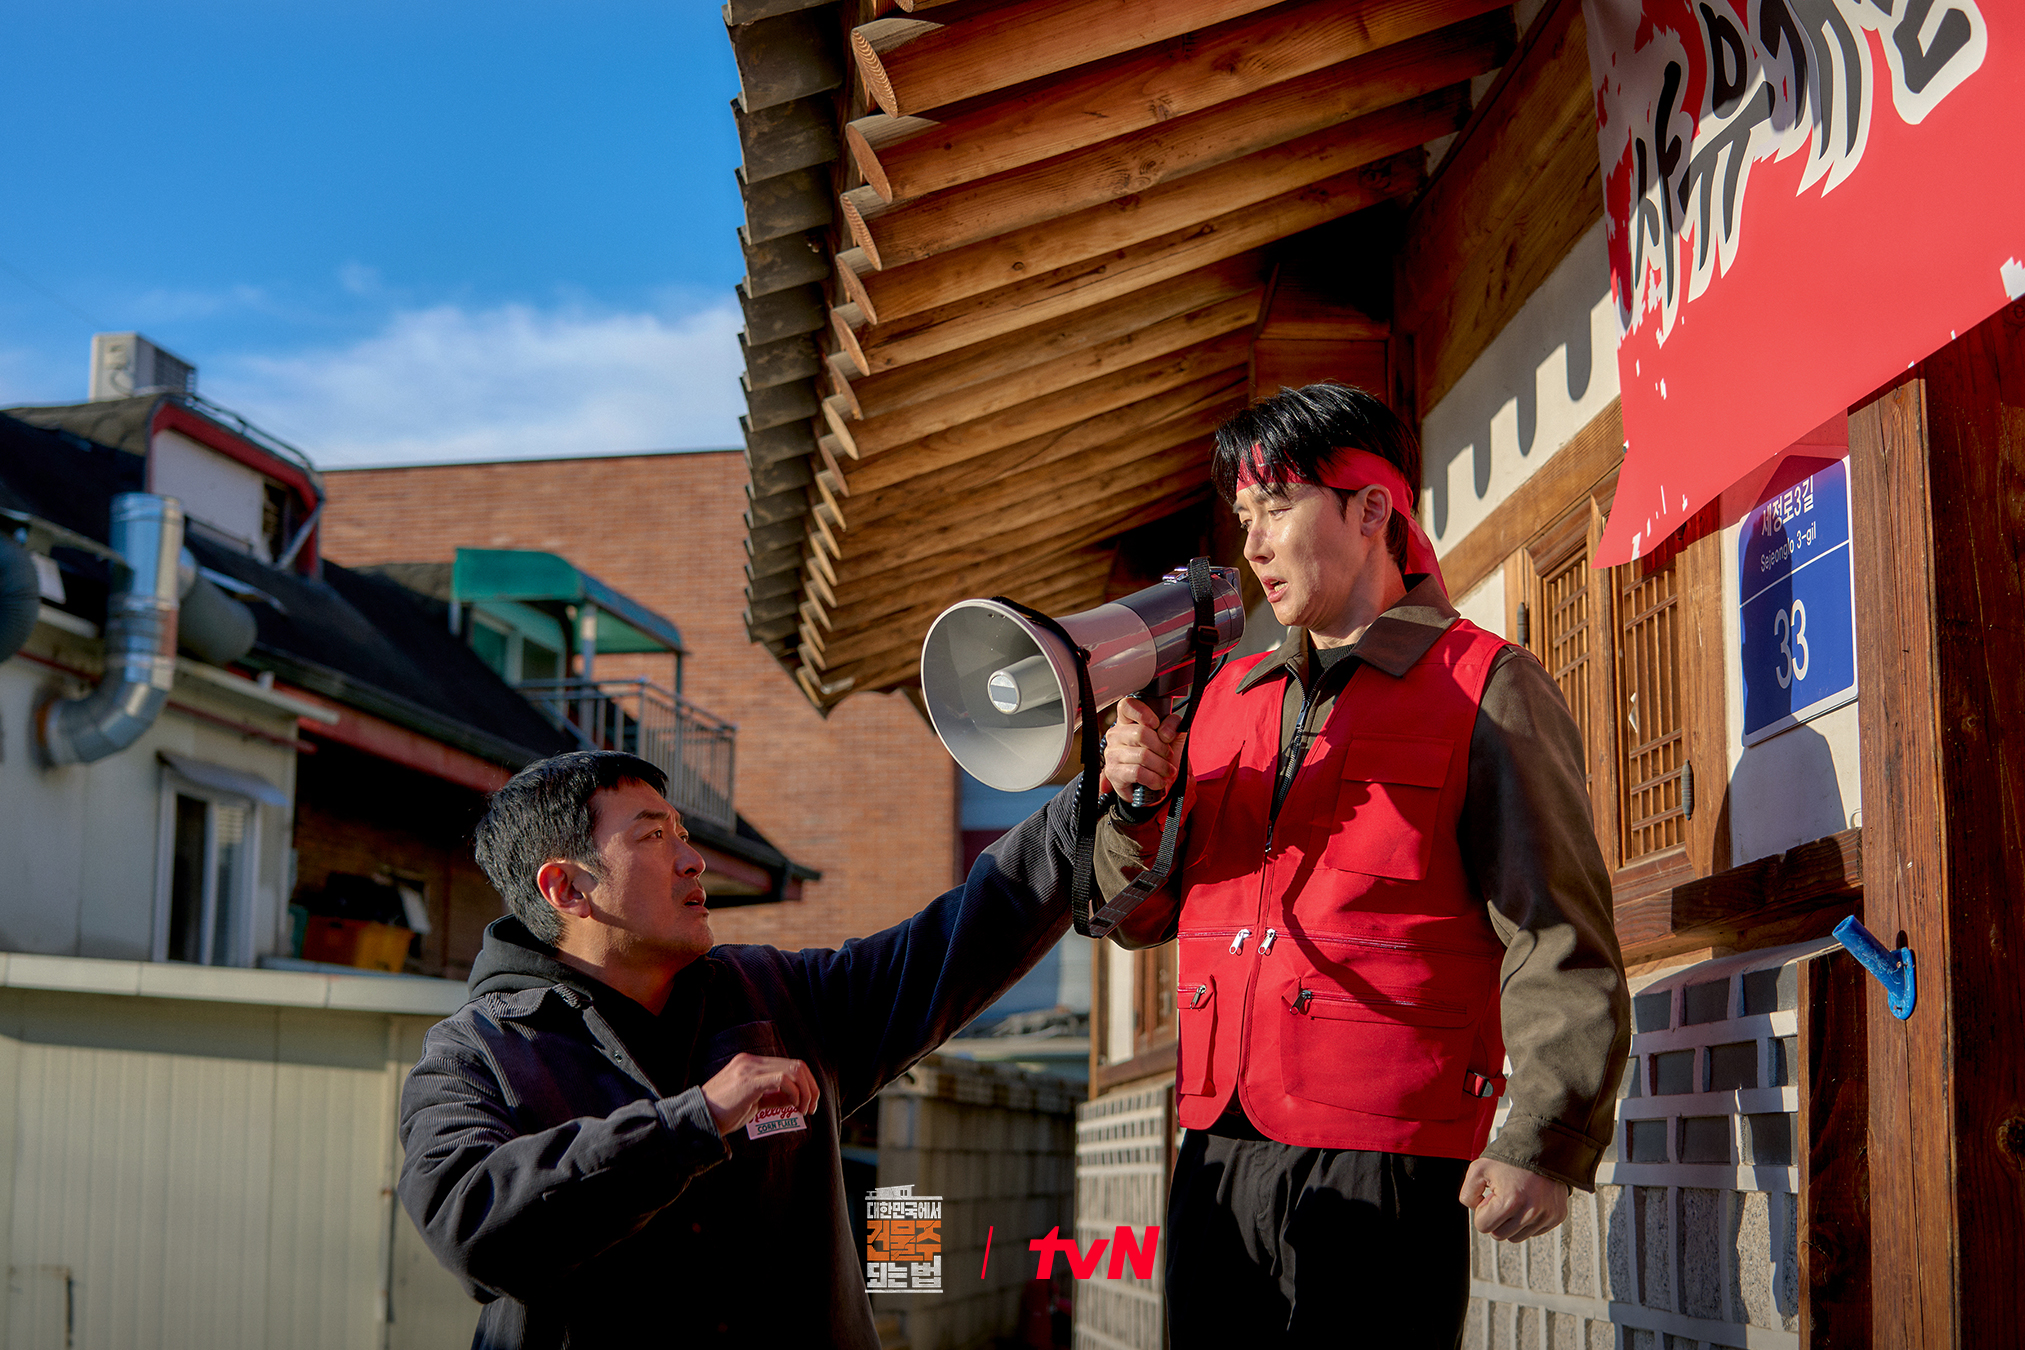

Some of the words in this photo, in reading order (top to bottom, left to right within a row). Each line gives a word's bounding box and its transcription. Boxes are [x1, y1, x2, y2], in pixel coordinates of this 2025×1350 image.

[1761, 474, 1814, 537] 세정로3길
[1760, 537, 1795, 572] Sejeonglo
[1796, 520, 1817, 549] 3-gil
[1773, 598, 1810, 690] 33
[757, 1122, 777, 1133] CORN
[777, 1119, 798, 1128] FLAKES
